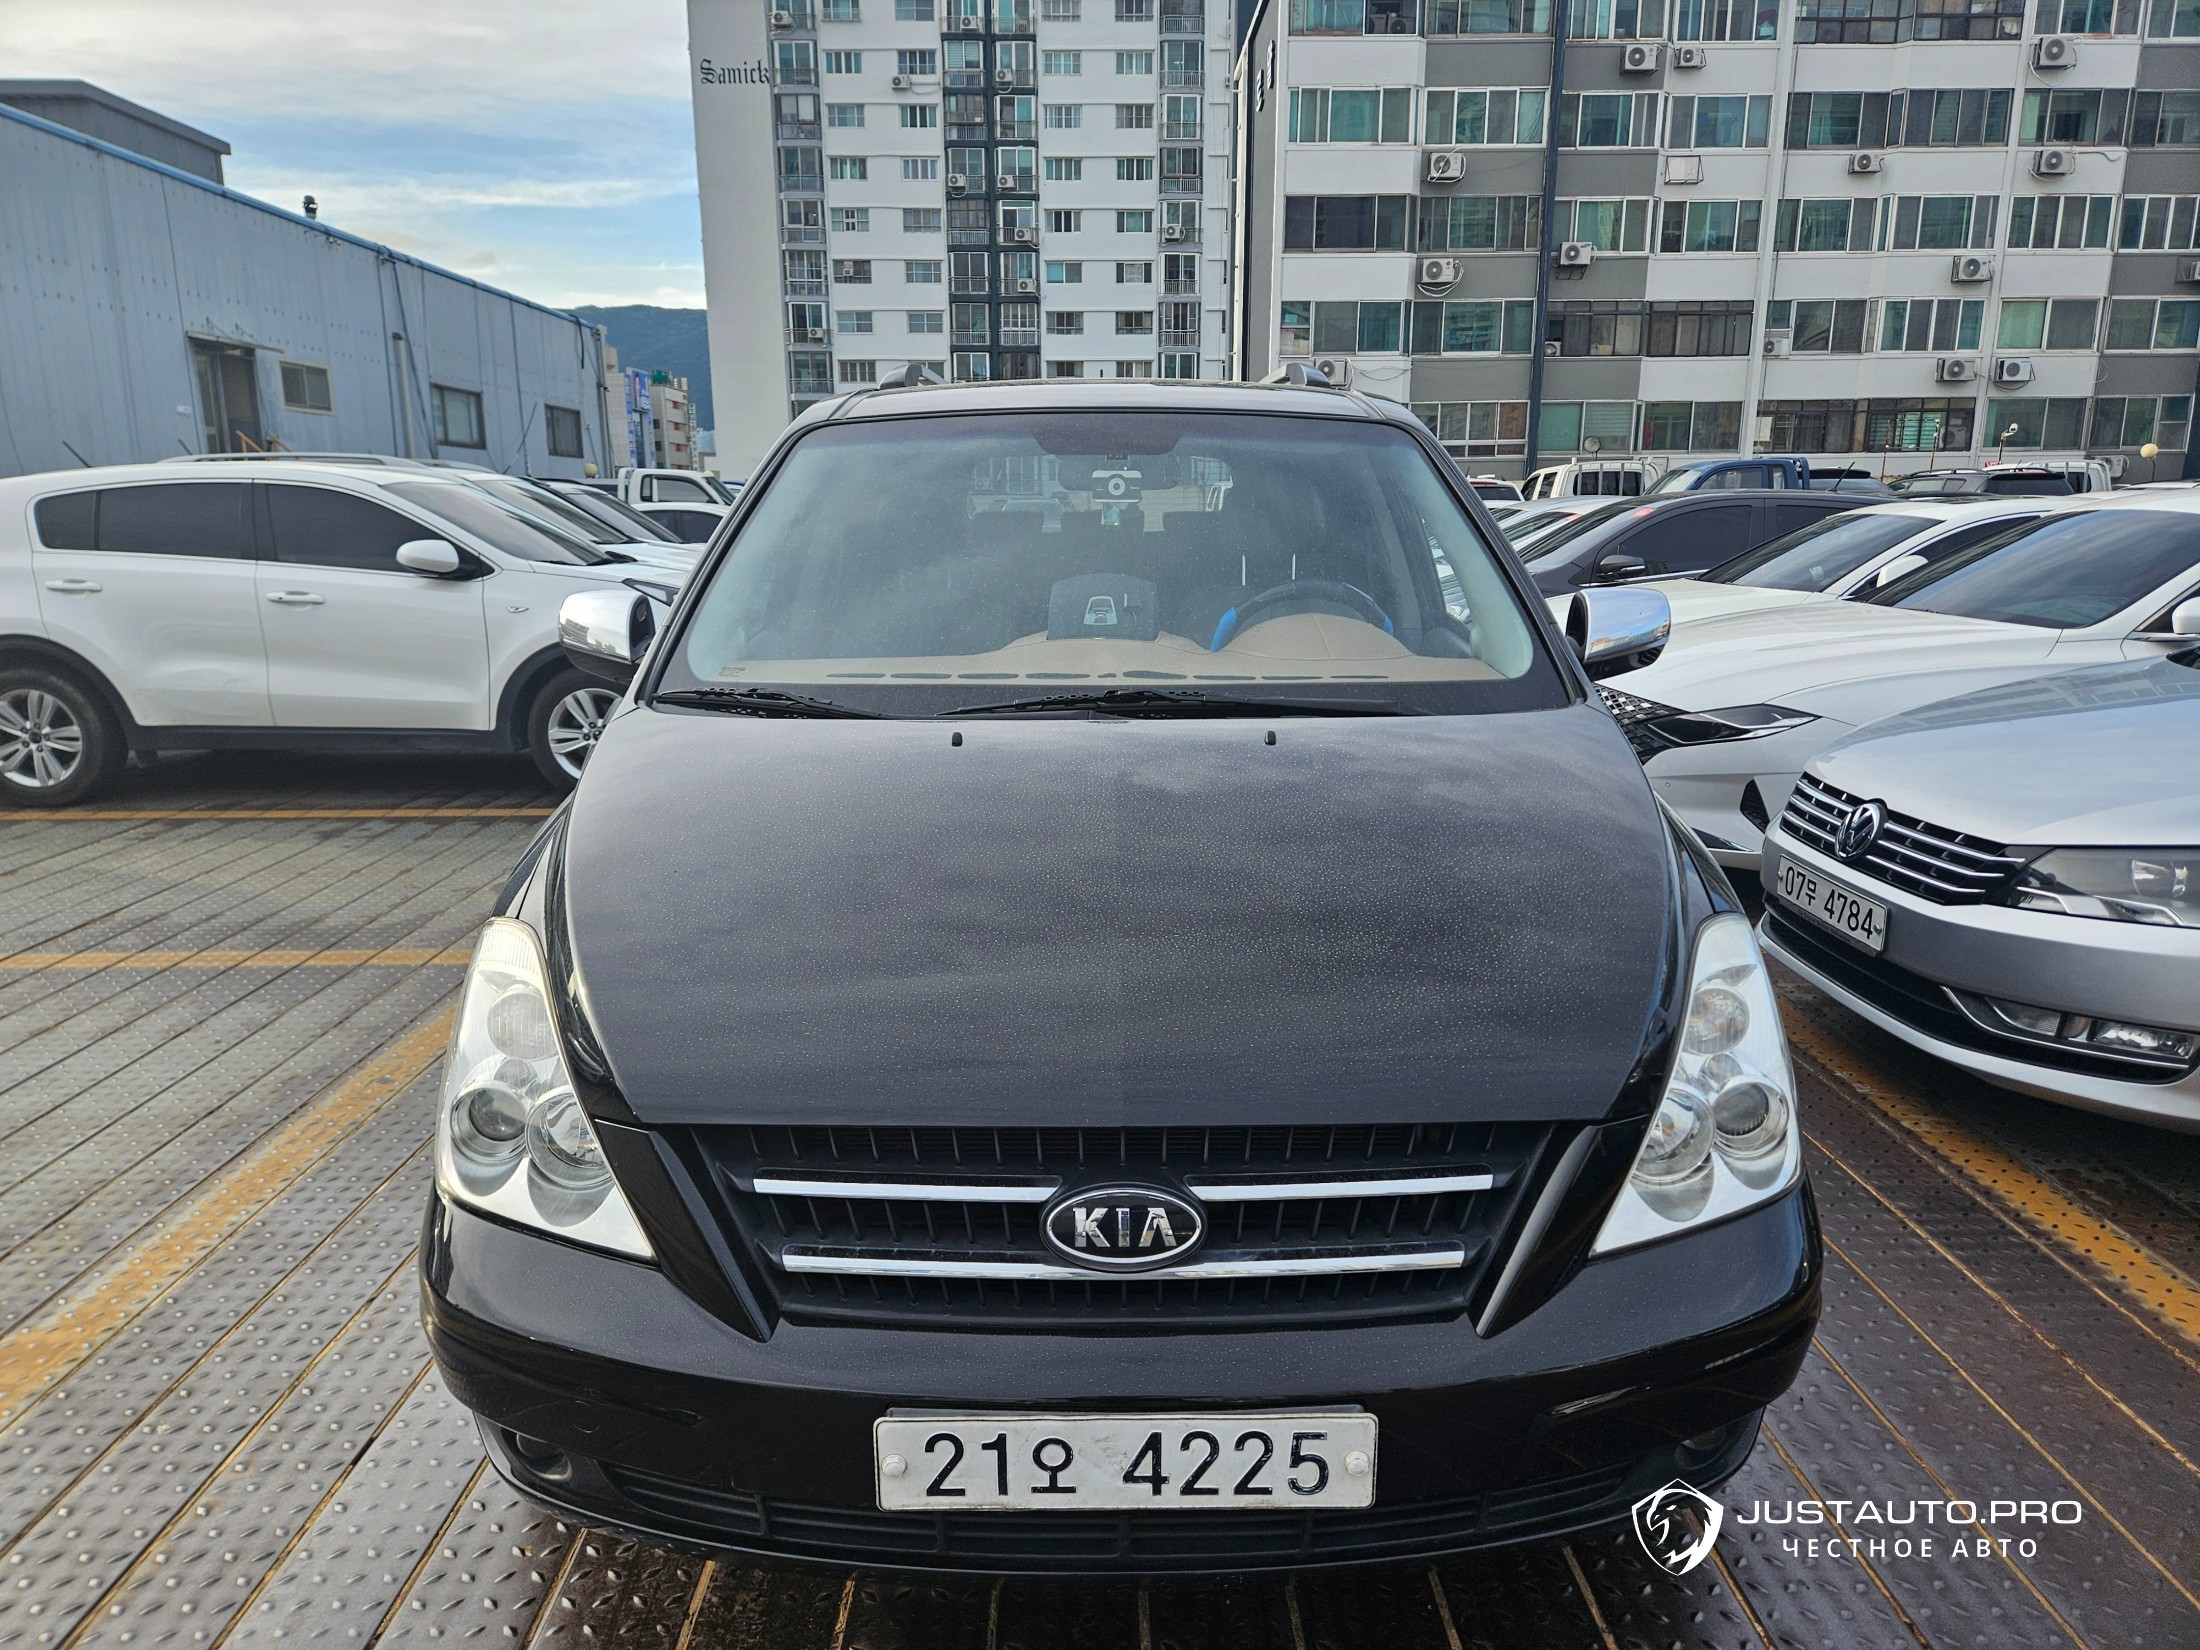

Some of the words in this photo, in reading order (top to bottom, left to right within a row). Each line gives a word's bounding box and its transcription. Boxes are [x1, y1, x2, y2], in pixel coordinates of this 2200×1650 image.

[700, 58, 770, 84] Samick
[1785, 866, 1817, 906] 07무
[1824, 889, 1874, 939] 4784
[1073, 1207, 1177, 1248] KIA
[924, 1432, 1077, 1496] 21오
[1122, 1431, 1330, 1496] 4225
